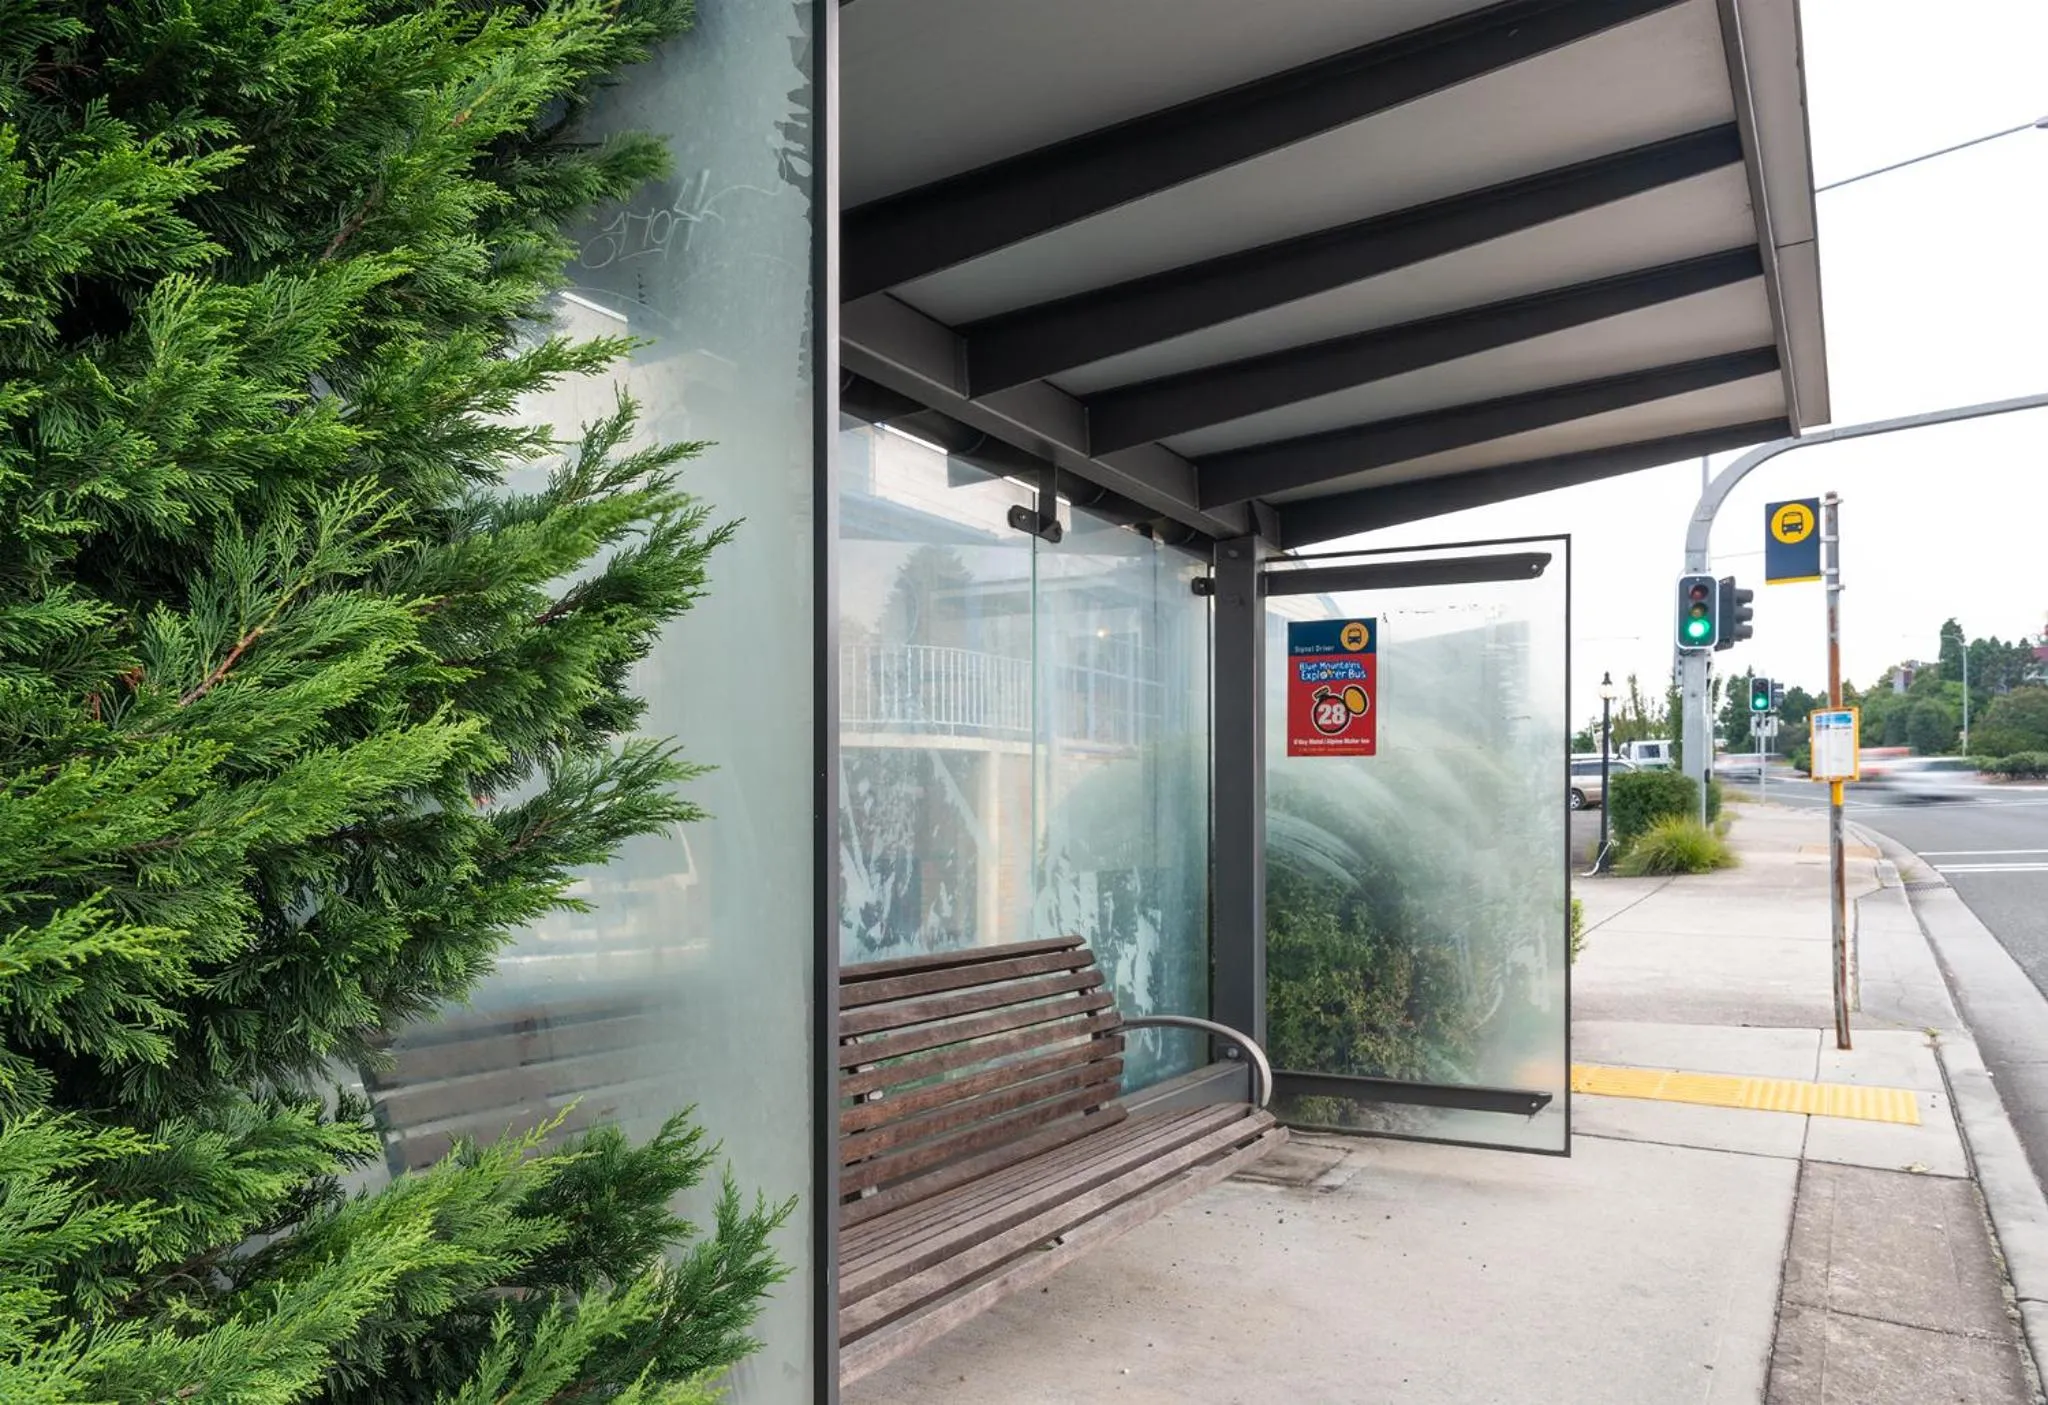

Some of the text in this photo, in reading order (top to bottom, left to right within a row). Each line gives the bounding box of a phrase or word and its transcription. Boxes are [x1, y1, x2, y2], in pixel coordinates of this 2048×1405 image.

[1300, 661, 1361, 671] Blue Mountains
[1301, 668, 1367, 682] Explorer Bus
[1318, 704, 1347, 725] 28
